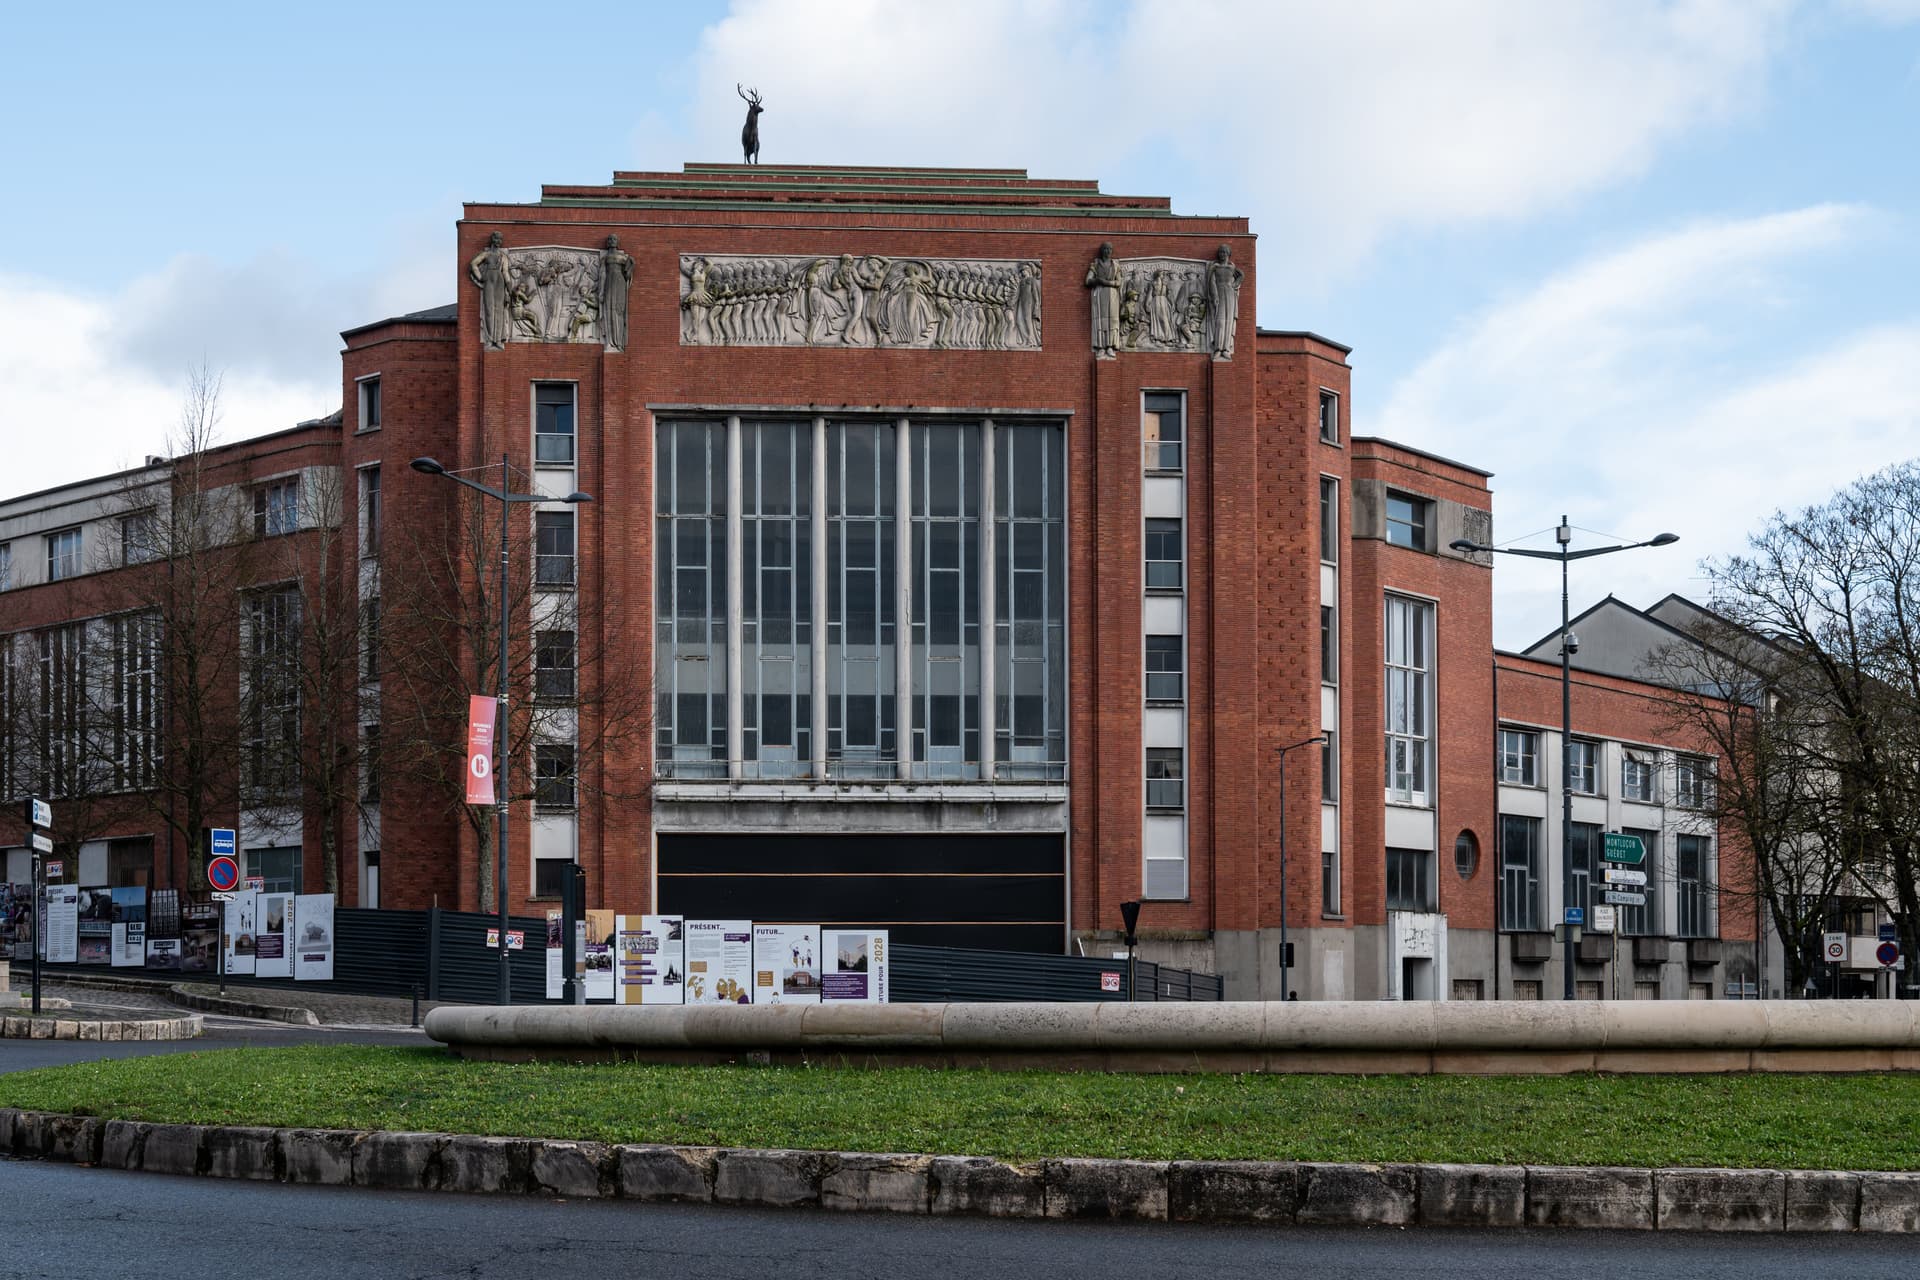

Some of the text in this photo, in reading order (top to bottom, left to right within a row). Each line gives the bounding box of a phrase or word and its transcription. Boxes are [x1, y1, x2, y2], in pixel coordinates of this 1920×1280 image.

[1606, 837, 1636, 849] MONTLUÇON
[1606, 848, 1626, 858] GUÉRET
[873, 937, 883, 962] 2028
